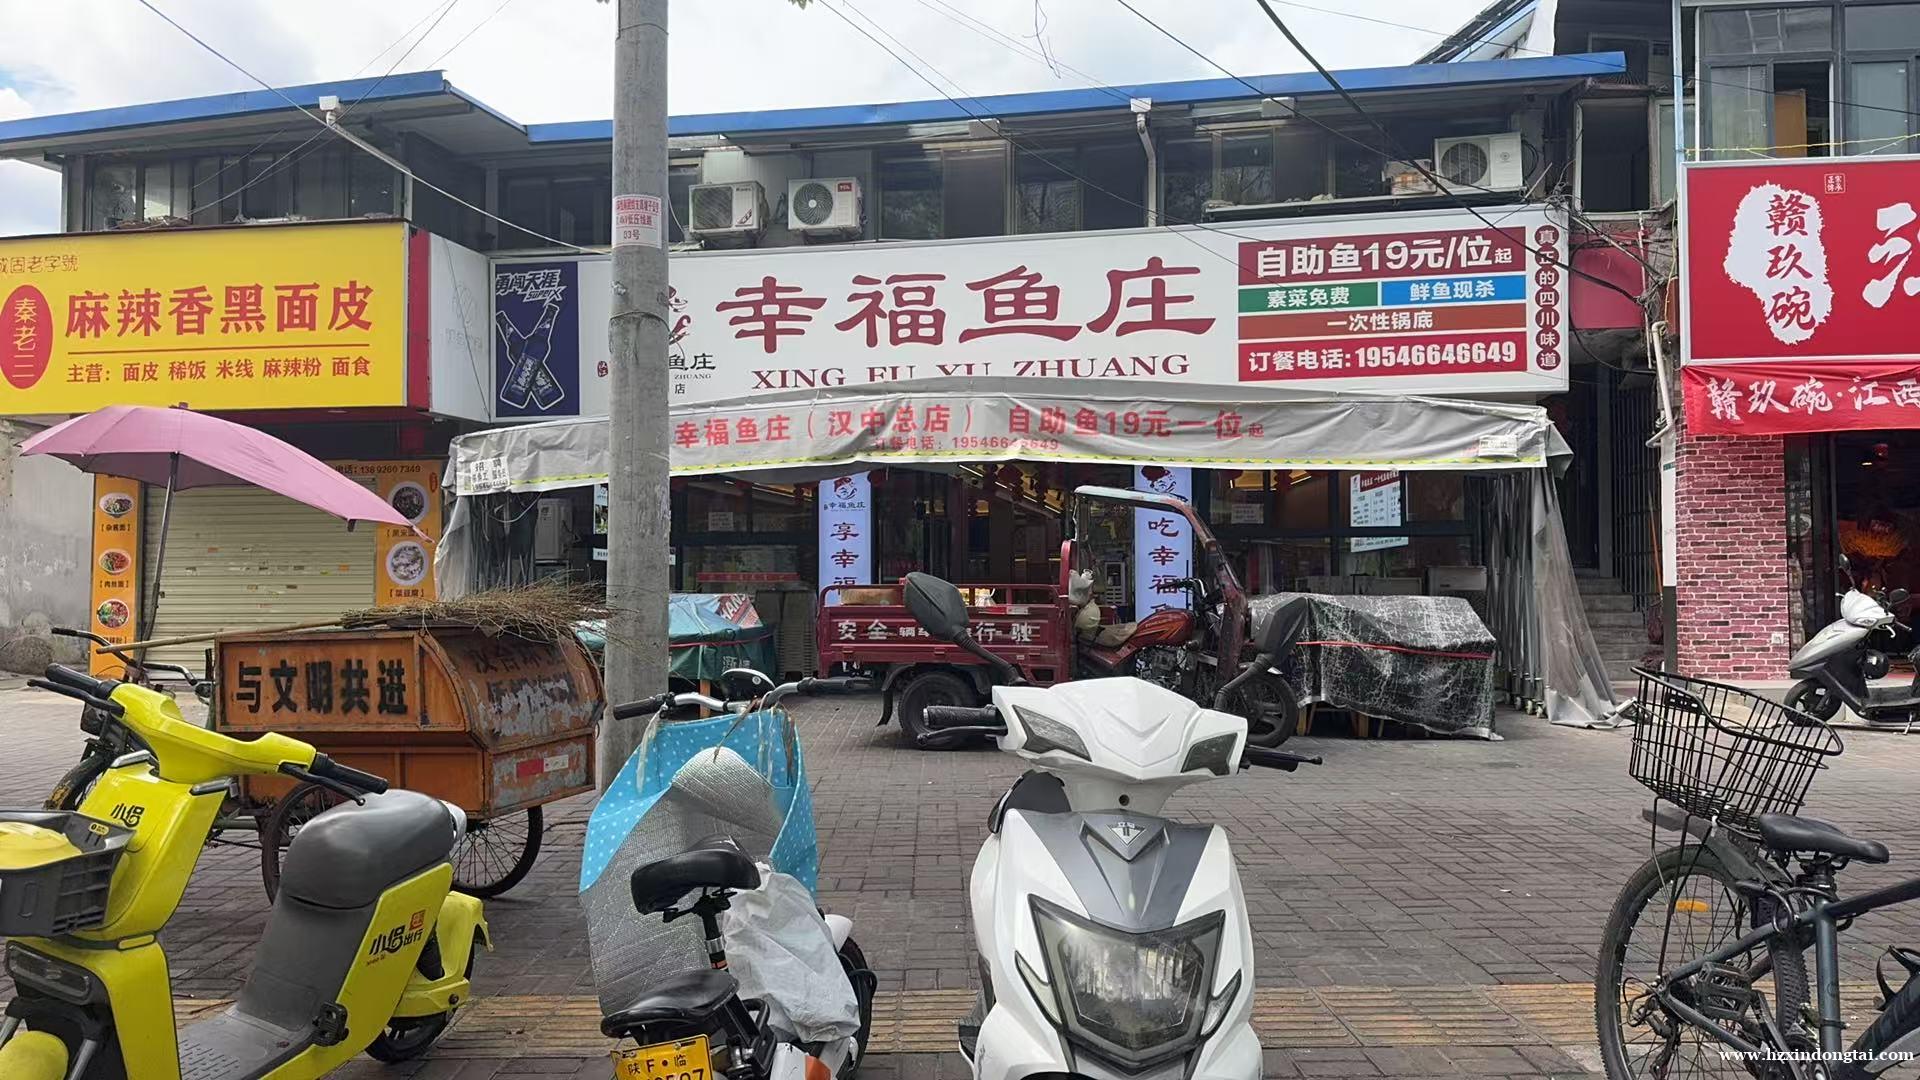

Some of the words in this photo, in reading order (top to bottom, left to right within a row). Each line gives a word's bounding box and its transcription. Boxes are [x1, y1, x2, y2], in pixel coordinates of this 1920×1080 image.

[1765, 193, 1816, 331] 赣玖碗
[496, 270, 561, 295] 勇闯天涯
[1267, 286, 1350, 308] 素菜免费
[1409, 280, 1496, 301] 鲜鱼现杀
[1539, 230, 1557, 367] 真正的四川味道
[65, 279, 375, 339] 麻辣香黑面皮
[715, 256, 1216, 354] 幸福鱼庄
[1327, 309, 1434, 332] 一次性锅底
[123, 361, 158, 383] 面皮
[168, 360, 207, 380] 稀饭
[216, 359, 254, 378] 米线
[262, 358, 322, 378] 麻辣粉
[332, 355, 371, 377] 面食
[751, 367, 845, 390] XING
[868, 364, 917, 383] FU
[1013, 354, 1190, 378] ZHUANG
[837, 618, 887, 641] 安全
[235, 658, 408, 716] 与文明共进
